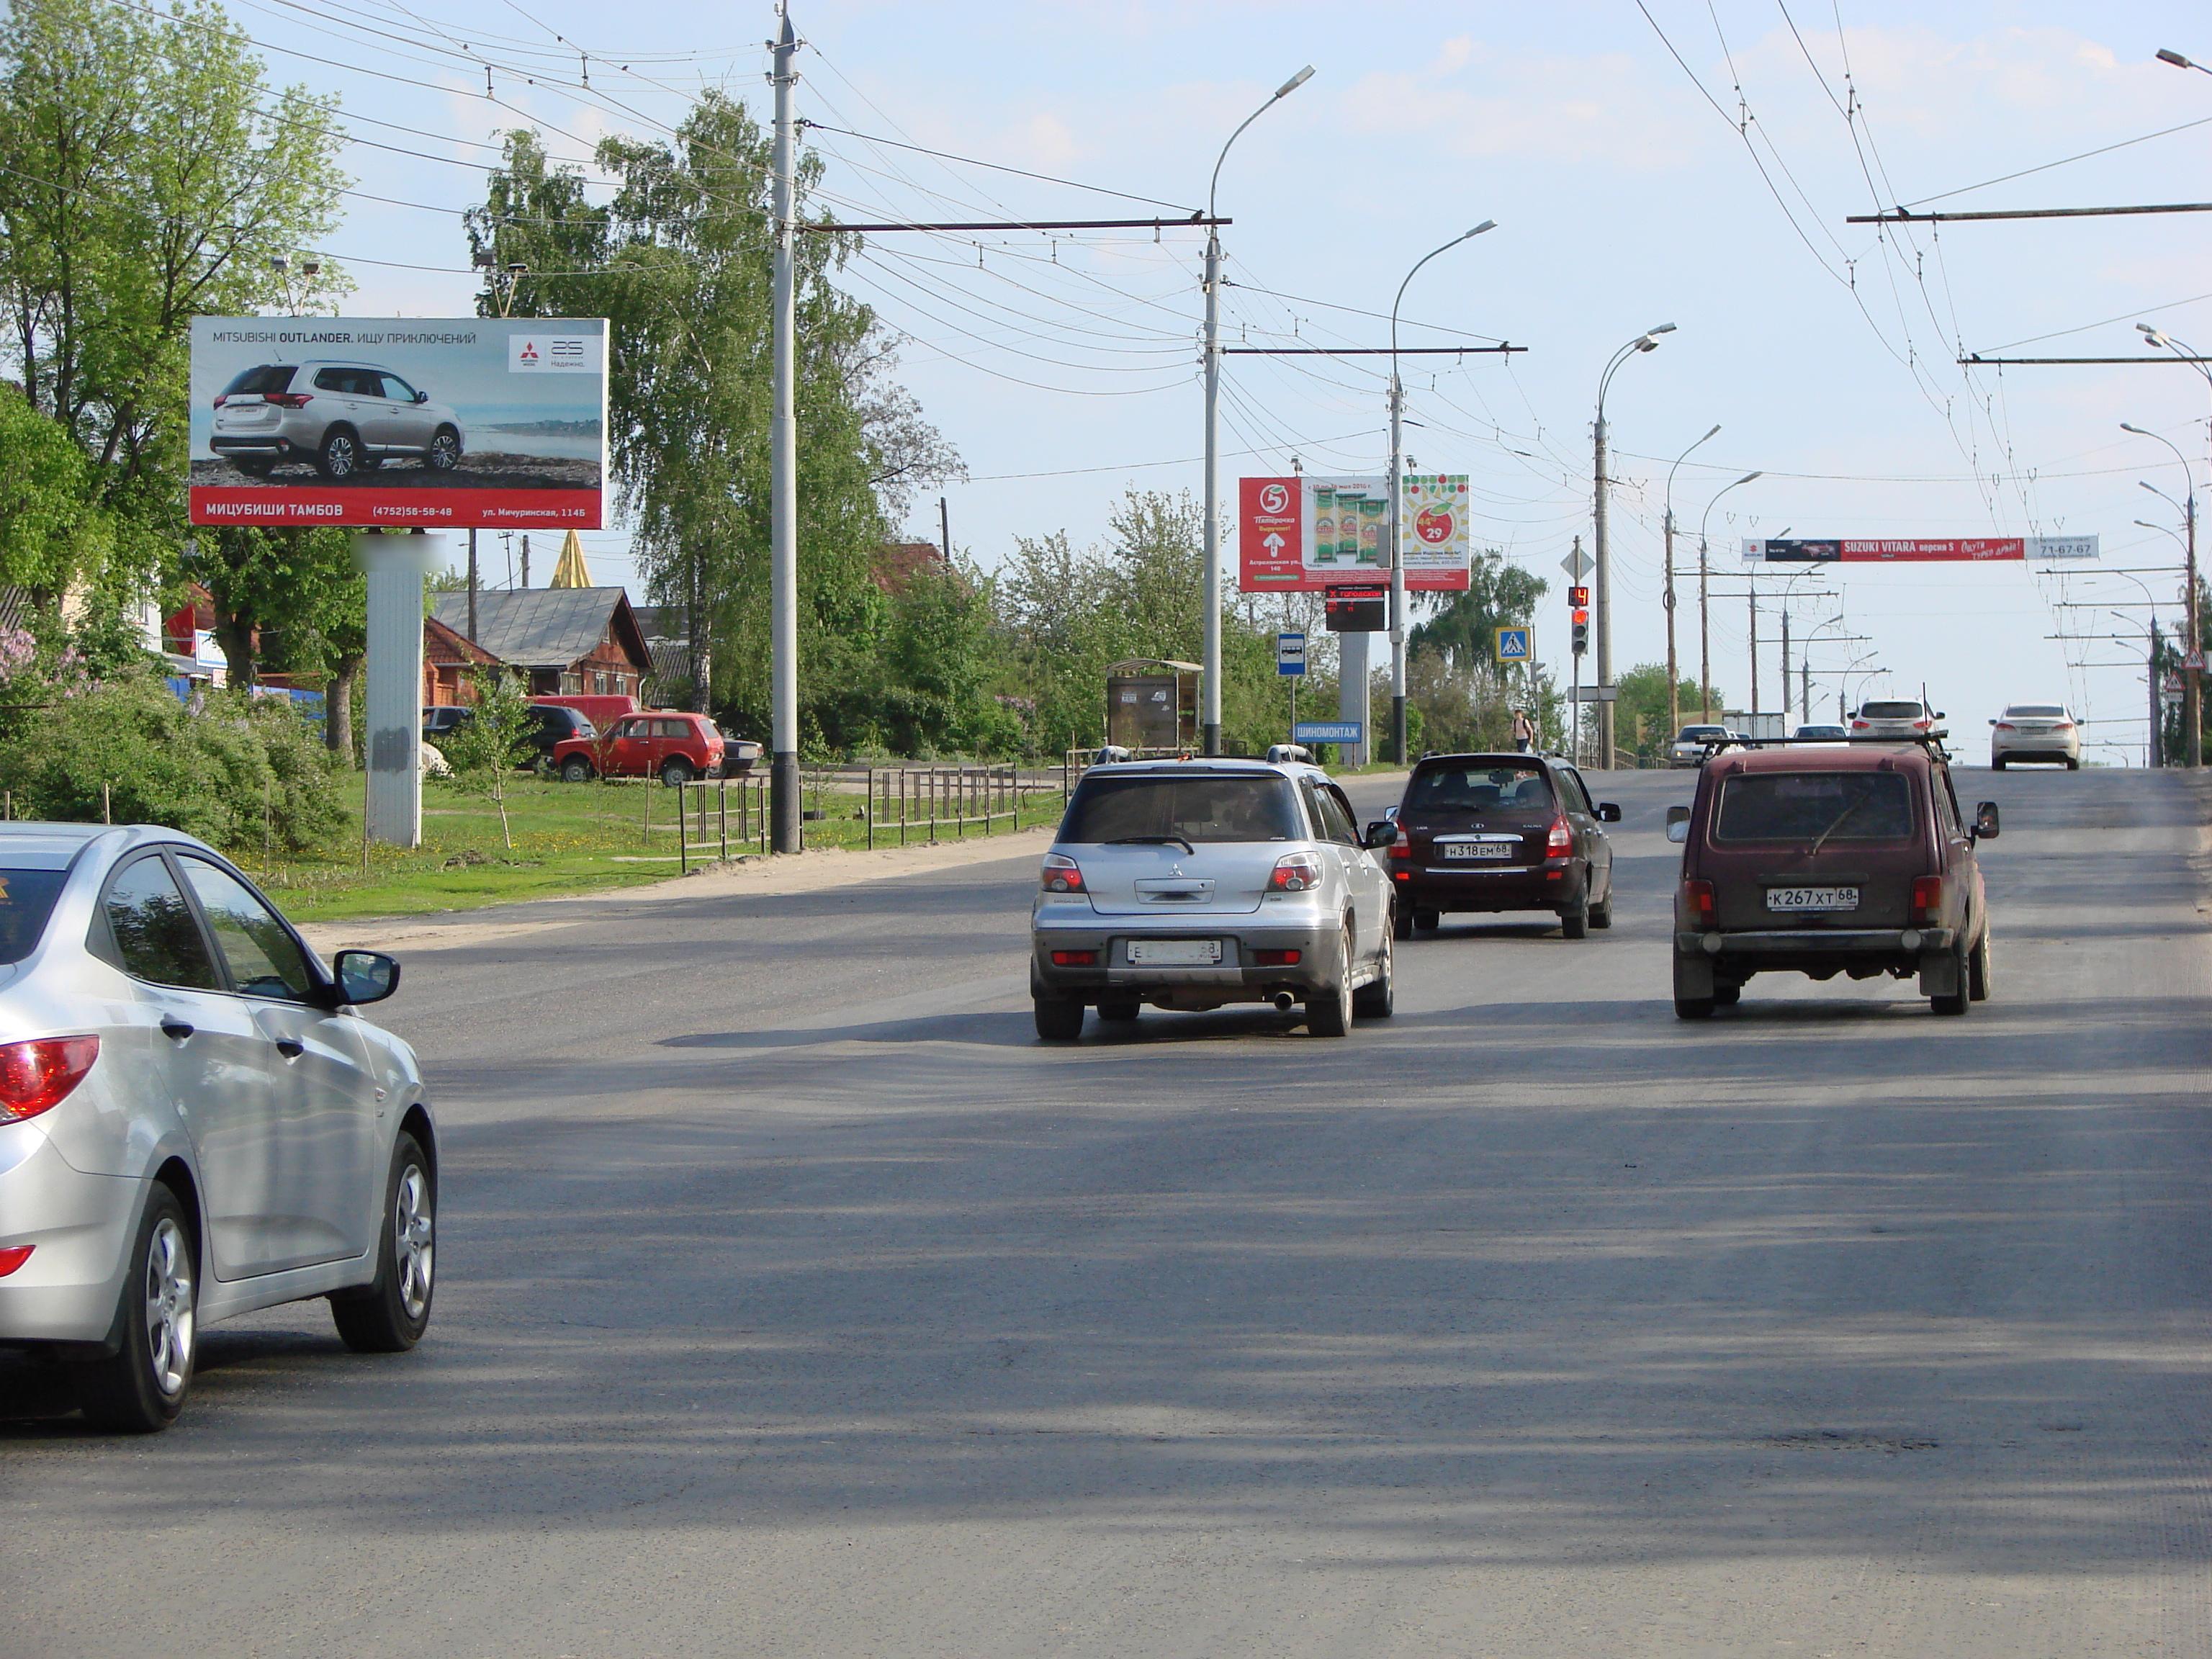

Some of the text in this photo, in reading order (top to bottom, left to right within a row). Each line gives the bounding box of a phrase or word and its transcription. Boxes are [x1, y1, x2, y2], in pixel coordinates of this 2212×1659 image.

[213, 332, 476, 346] MITSUBISHI OUTLANDER. ИЩУ ПРИКЛЮЧЕНИЙ
[206, 503, 343, 516] МИЦУБИШИ ТАМБОВ
[373, 506, 452, 517] (4752)56-58-48
[498, 508, 558, 518] Мичуринская,
[1426, 528, 1443, 539] 29
[1845, 541, 1879, 552] SUZUKI
[1881, 541, 1916, 552] VITARA
[1920, 544, 1947, 553] версия
[2041, 545, 2090, 554] 71-67-67
[1578, 588, 1587, 605] 4
[1298, 726, 1358, 739] ШИНОМОНТАЖ
